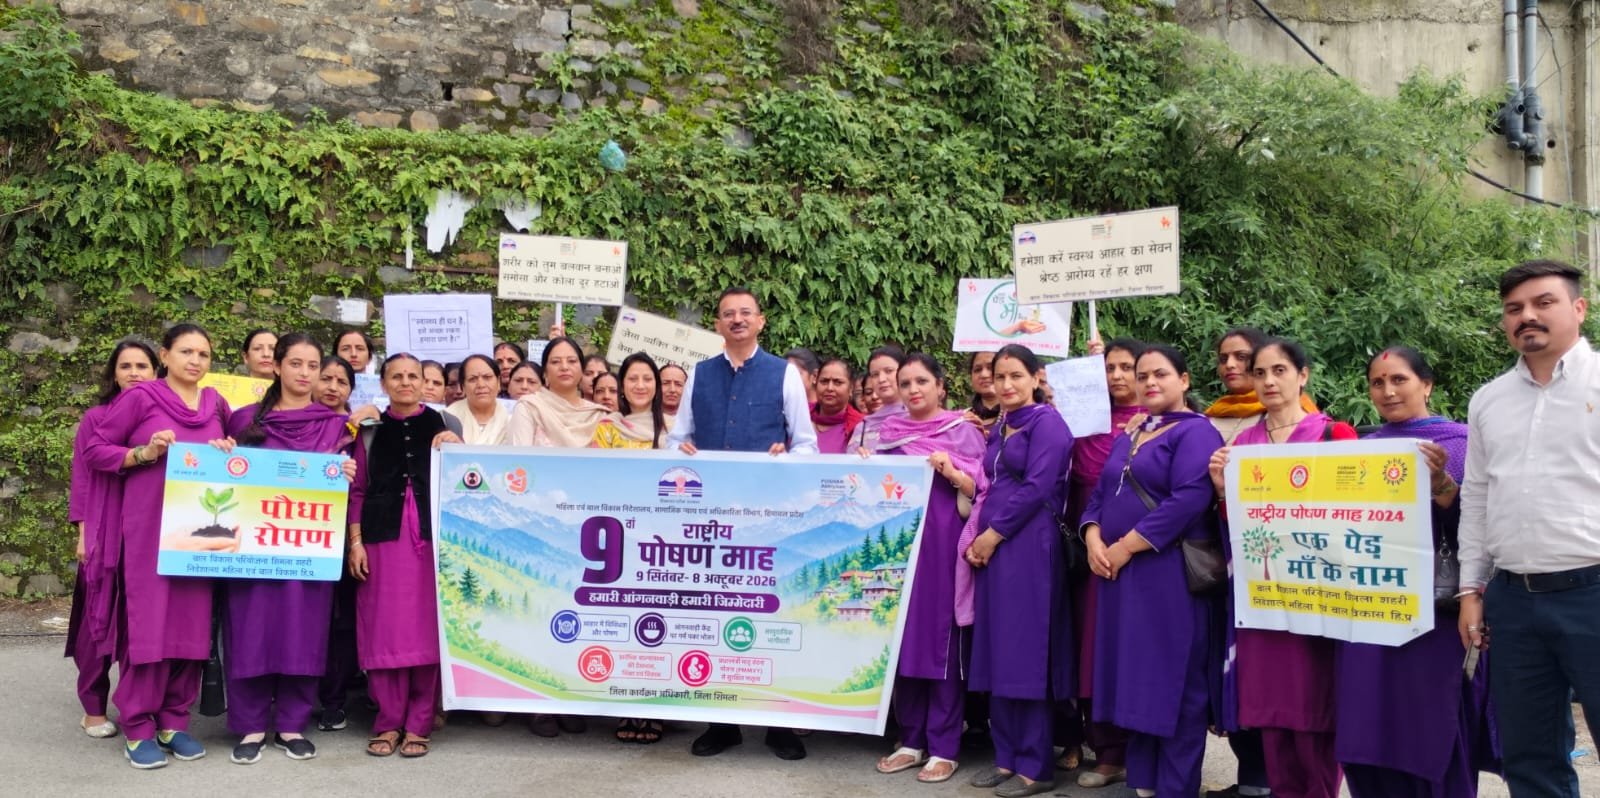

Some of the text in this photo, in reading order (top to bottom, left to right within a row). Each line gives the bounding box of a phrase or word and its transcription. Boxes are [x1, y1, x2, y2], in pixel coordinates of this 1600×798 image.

[1020, 253, 1044, 268] हमेशा
[1049, 250, 1064, 264] करें
[1100, 247, 1125, 260] आहार
[1130, 245, 1144, 256] का
[1149, 240, 1172, 255] सेवन
[502, 258, 522, 268] शरीर
[526, 258, 538, 269] को
[542, 262, 556, 274] तुम
[595, 262, 622, 274] बनाओ
[1064, 266, 1095, 282] आरोग्य
[1100, 264, 1112, 278] रहें
[1116, 266, 1128, 277] हर
[1134, 264, 1152, 276] क्षण
[502, 271, 620, 289] समोसा और कोला दूर हटाओ
[672, 344, 684, 354] का
[260, 494, 334, 522] पौधा
[1247, 504, 1405, 524] राष्ट्रीय पोषण माह 2024
[254, 522, 335, 548] रोपण
[682, 520, 734, 542] राष्ट्रीय
[580, 516, 624, 584] 9
[638, 534, 777, 572] पोषण माह
[1290, 529, 1383, 559] एक पेड़
[636, 572, 644, 582] 9
[692, 573, 700, 583] 8
[704, 573, 743, 589] अक्टूबर
[746, 576, 776, 586] 2026
[1287, 555, 1408, 588] माँ के नाम
[589, 592, 764, 608] हमारी आंगनवाड़ी हमारी जिम्मेदारी
[1380, 595, 1408, 606] शहरी
[609, 686, 628, 696] जिला
[629, 688, 656, 697] कार्यक्रम
[694, 690, 712, 700] जिला
[714, 690, 738, 701] शिमला
